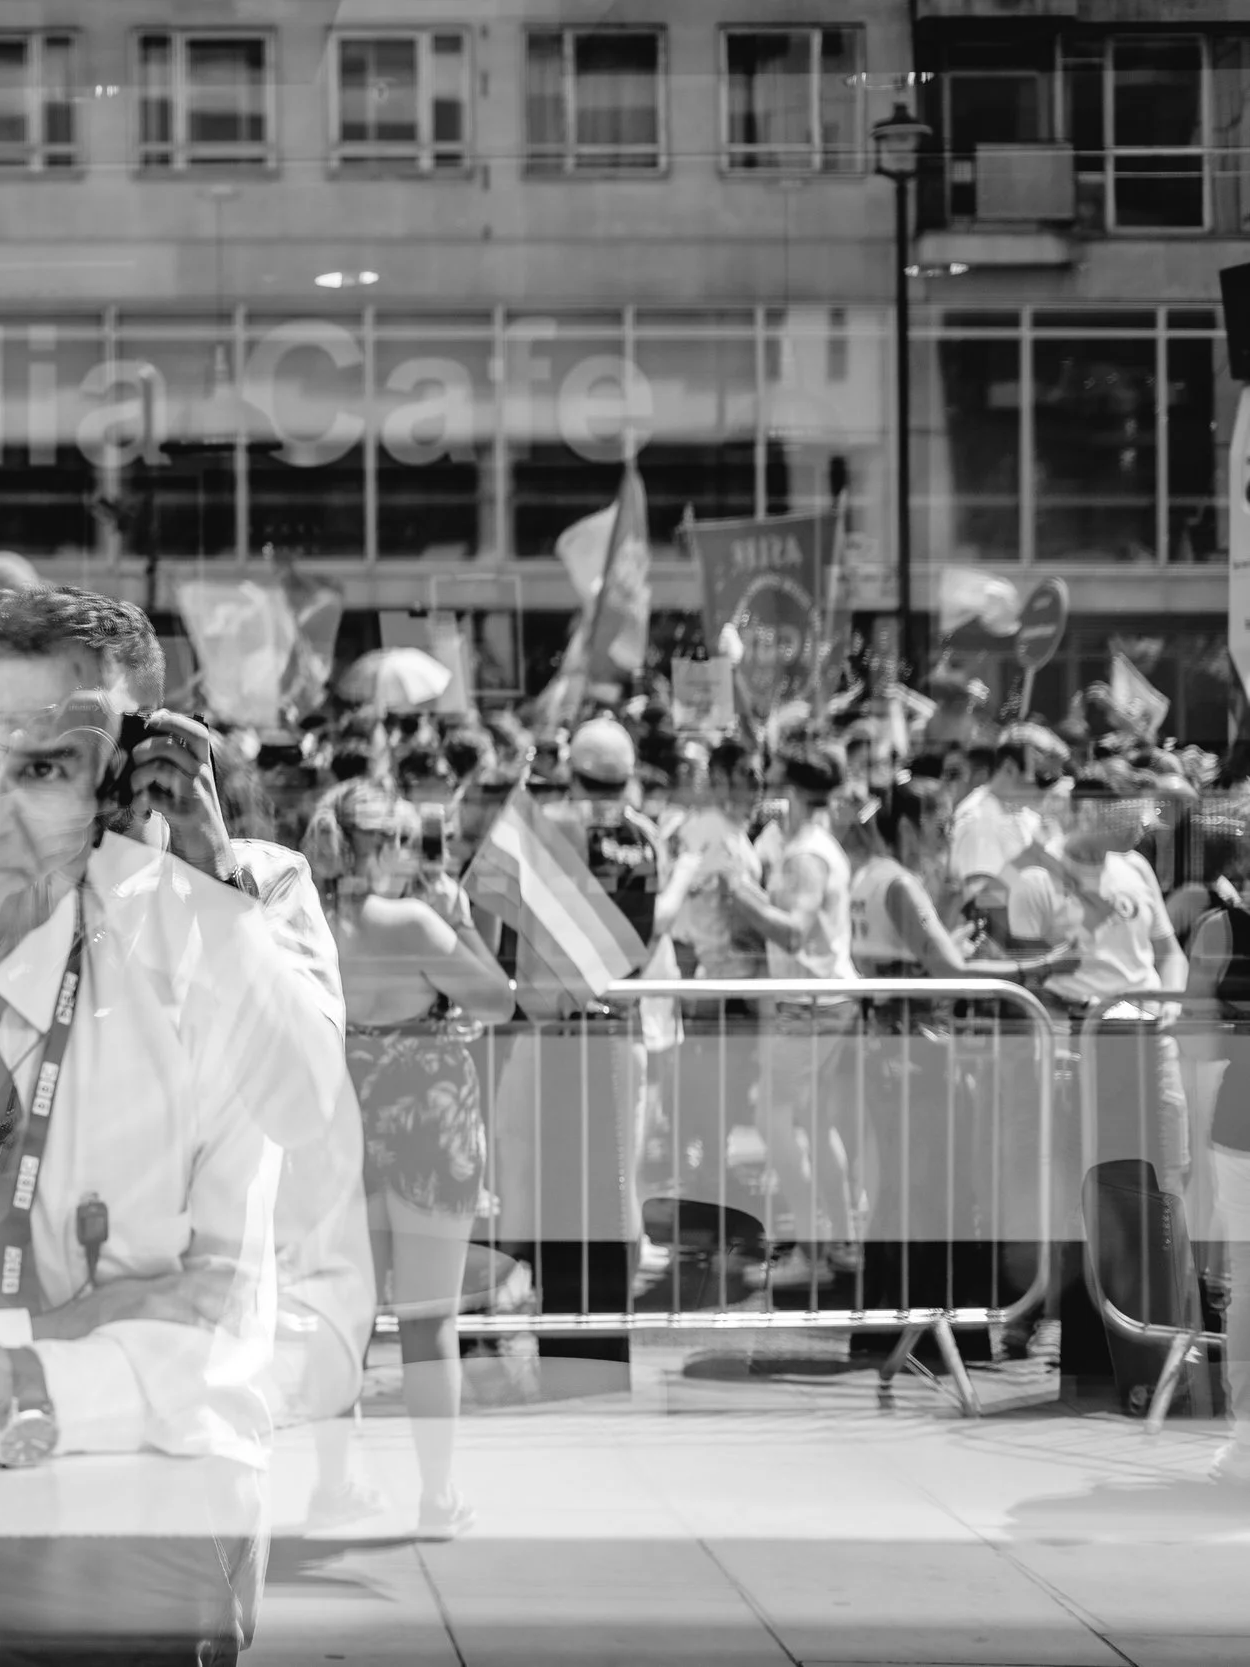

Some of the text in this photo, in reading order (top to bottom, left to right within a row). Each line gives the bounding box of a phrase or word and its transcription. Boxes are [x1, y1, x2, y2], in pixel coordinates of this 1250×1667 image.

[242, 315, 653, 468] Cafe
[32, 1061, 59, 1118] BBC
[12, 1154, 40, 1211] BBC
